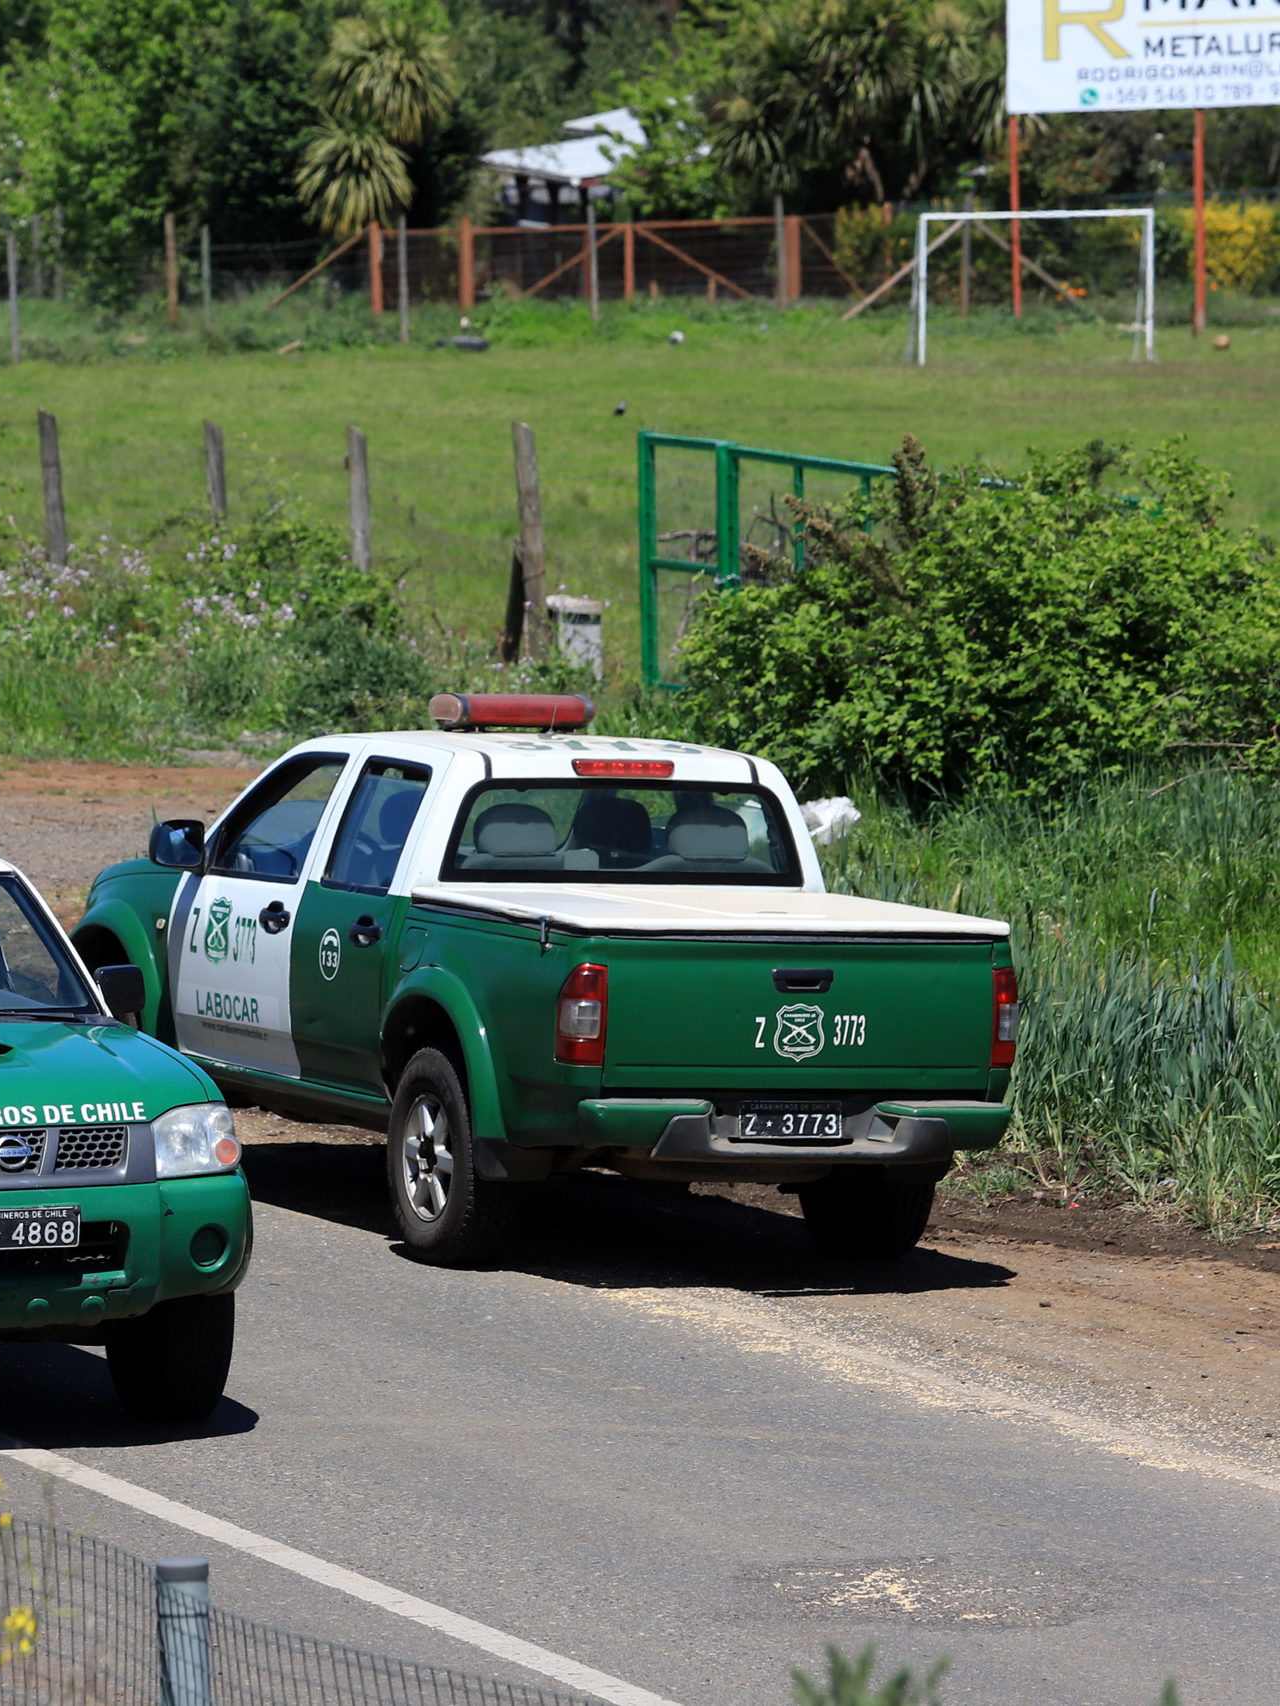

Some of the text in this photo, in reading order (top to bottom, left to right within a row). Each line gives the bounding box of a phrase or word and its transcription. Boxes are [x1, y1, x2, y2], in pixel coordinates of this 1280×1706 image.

[190, 907, 257, 965] Z 3773
[321, 950, 338, 968] 133
[196, 989, 260, 1023] LABOCAR
[754, 1015, 866, 1048] Z 3773
[43, 1104, 77, 1125] DE
[80, 1102, 147, 1122] CHILE
[745, 1113, 837, 1135] Z 3773
[32, 1210, 42, 1218] DE
[45, 1209, 68, 1218] CHILE
[11, 1221, 75, 1245] 4868
